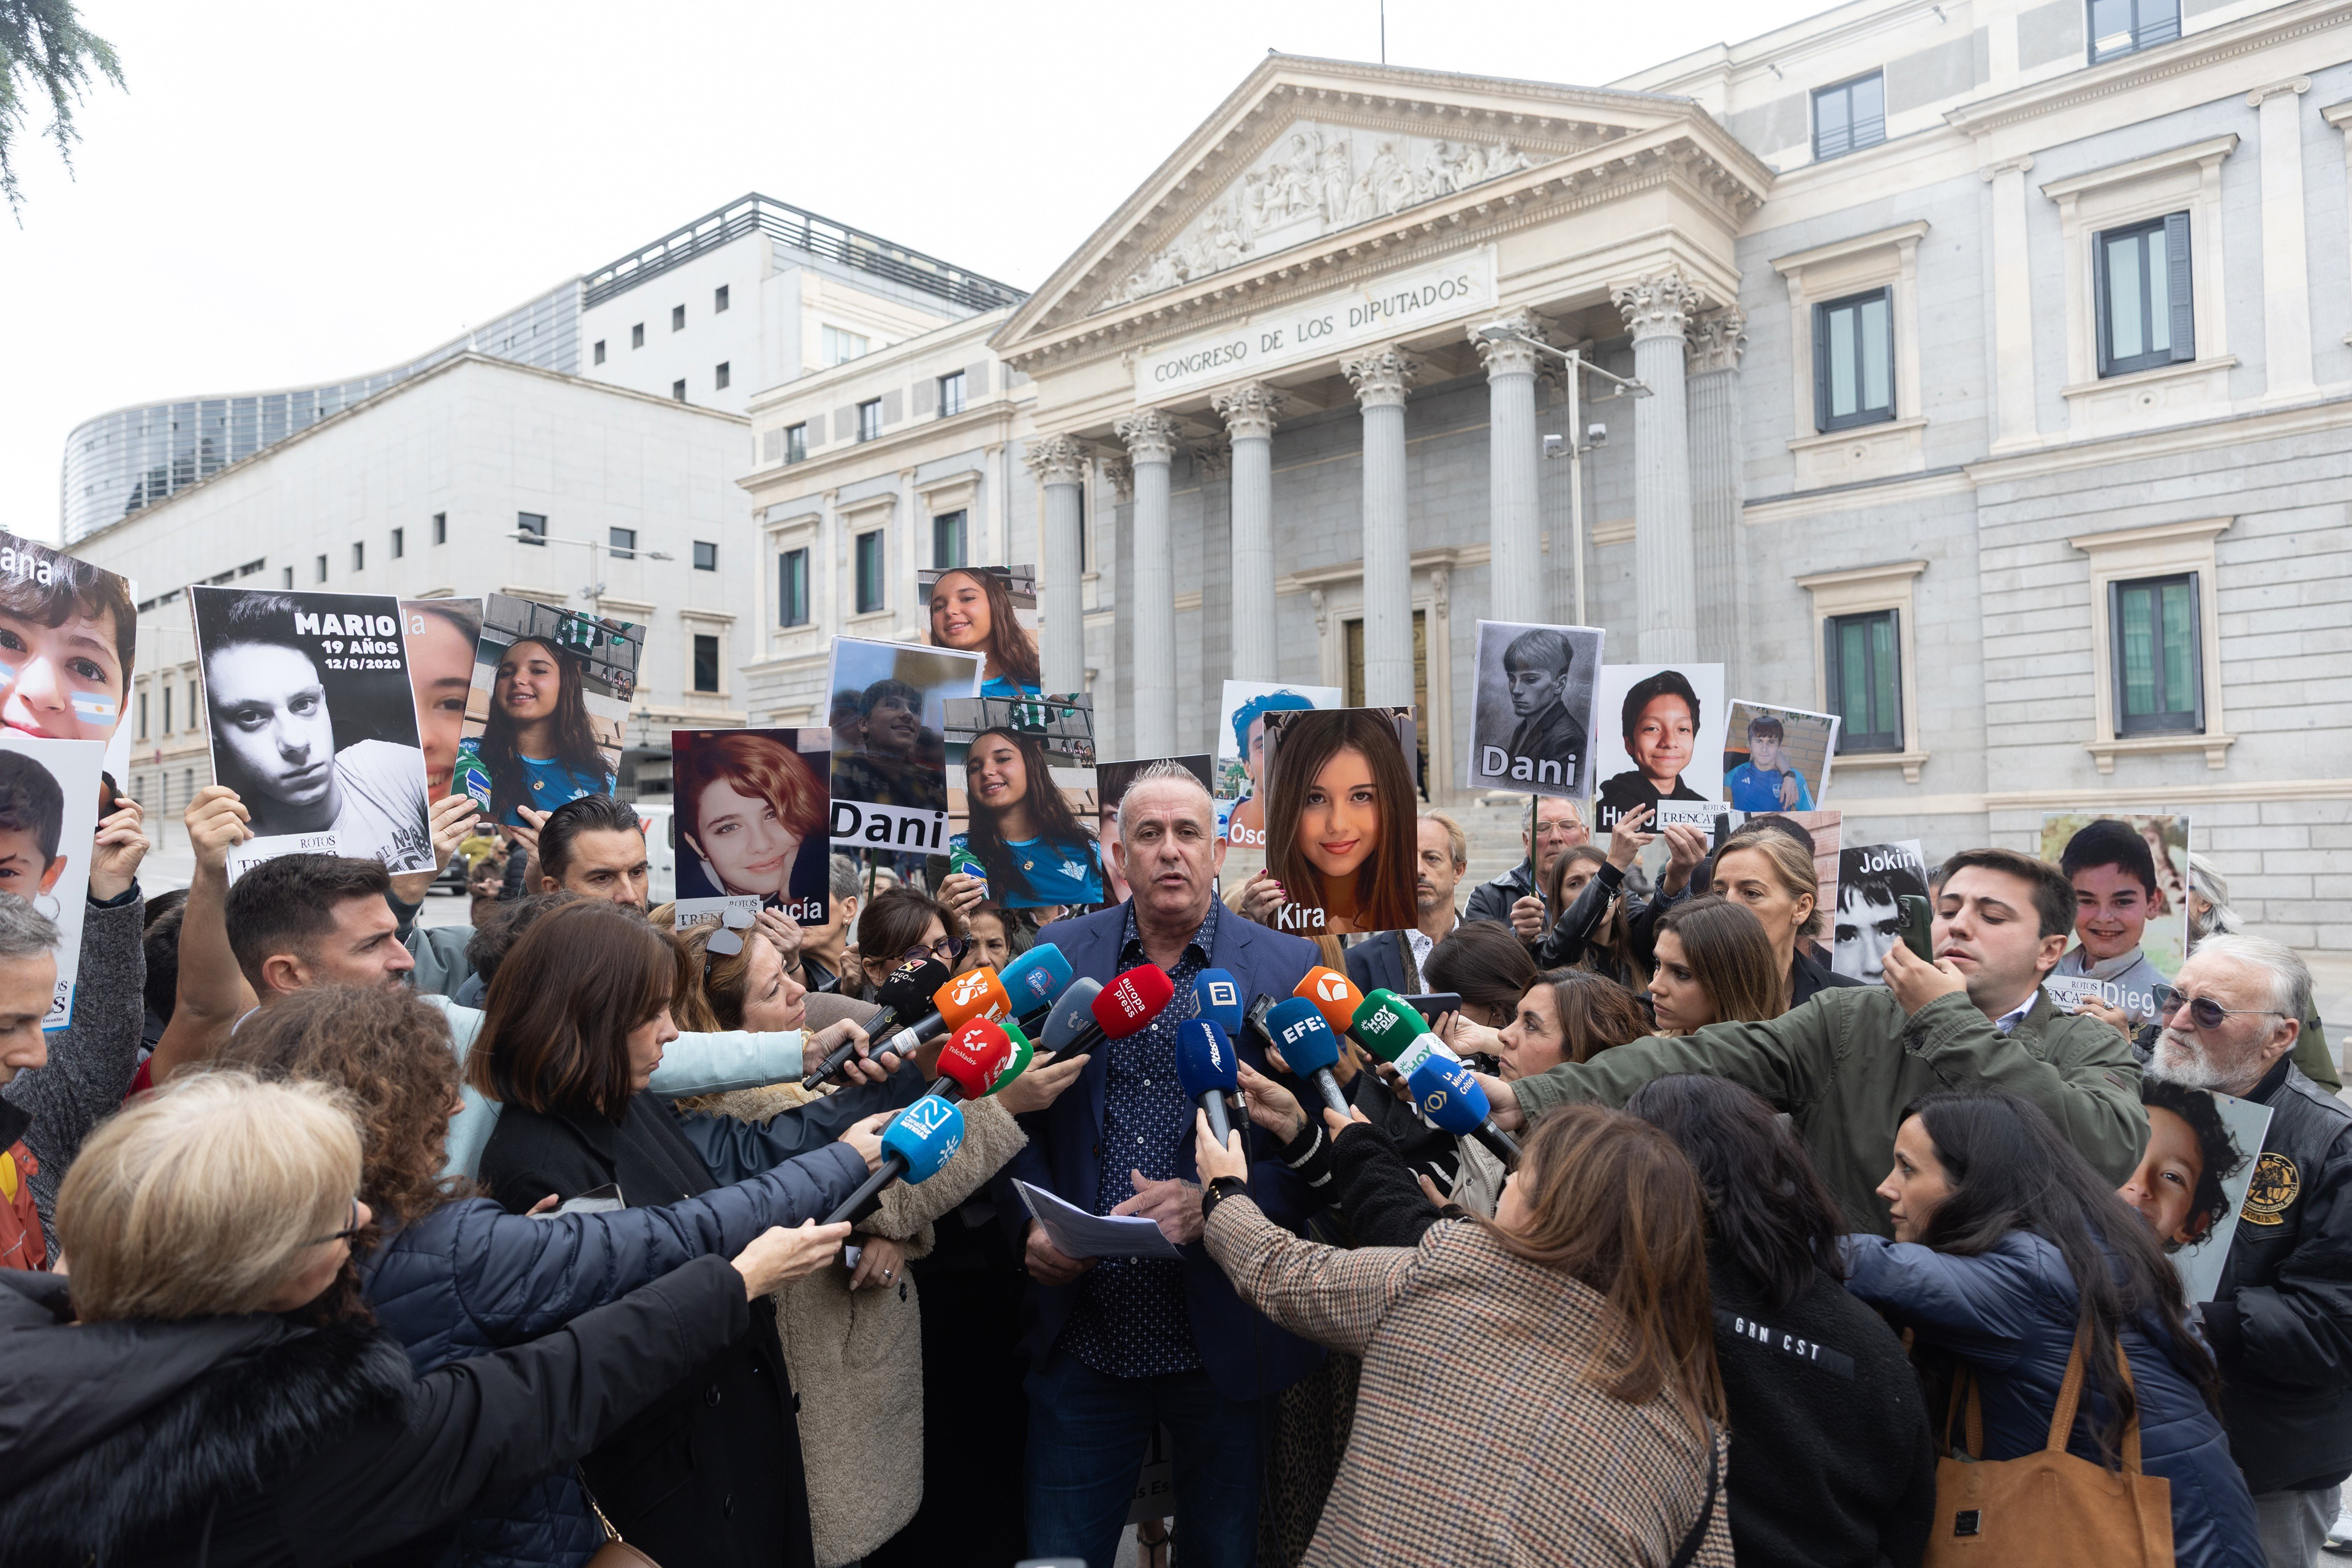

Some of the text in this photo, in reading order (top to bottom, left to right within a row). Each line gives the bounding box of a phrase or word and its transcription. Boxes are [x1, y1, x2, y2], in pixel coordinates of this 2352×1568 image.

[1155, 276, 1469, 382] CONGRESO DE LOS DIPUTADOS
[294, 612, 397, 637] MARIO
[321, 638, 399, 654] 19 AÑOS
[325, 658, 401, 670] 12/8/2020
[1481, 744, 1577, 787] Dani
[829, 801, 944, 849] Dani
[300, 835, 336, 849] ROTOS
[1859, 848, 1917, 873] Jokin
[1278, 903, 1325, 930] Kira
[1035, 971, 1043, 980] EL
[2071, 981, 2098, 991] ROTOS
[1114, 990, 1136, 1018] press
[1122, 978, 1145, 1012] europa
[2103, 981, 2156, 1018] Dieg
[1068, 1011, 1091, 1032] tv
[1366, 1004, 1389, 1030] HOY
[1373, 1024, 1382, 1035] EN
[1379, 1012, 1397, 1029] DÍA
[1442, 1071, 1453, 1081] La
[1451, 1068, 1469, 1088] Mirada
[1459, 1076, 1476, 1095] Crítica
[900, 1120, 929, 1140] NOTICIAS
[904, 1115, 932, 1135] CanalSur
[2267, 1201, 2284, 1210] CONTRA
[1735, 1317, 1821, 1361] GRN CST
